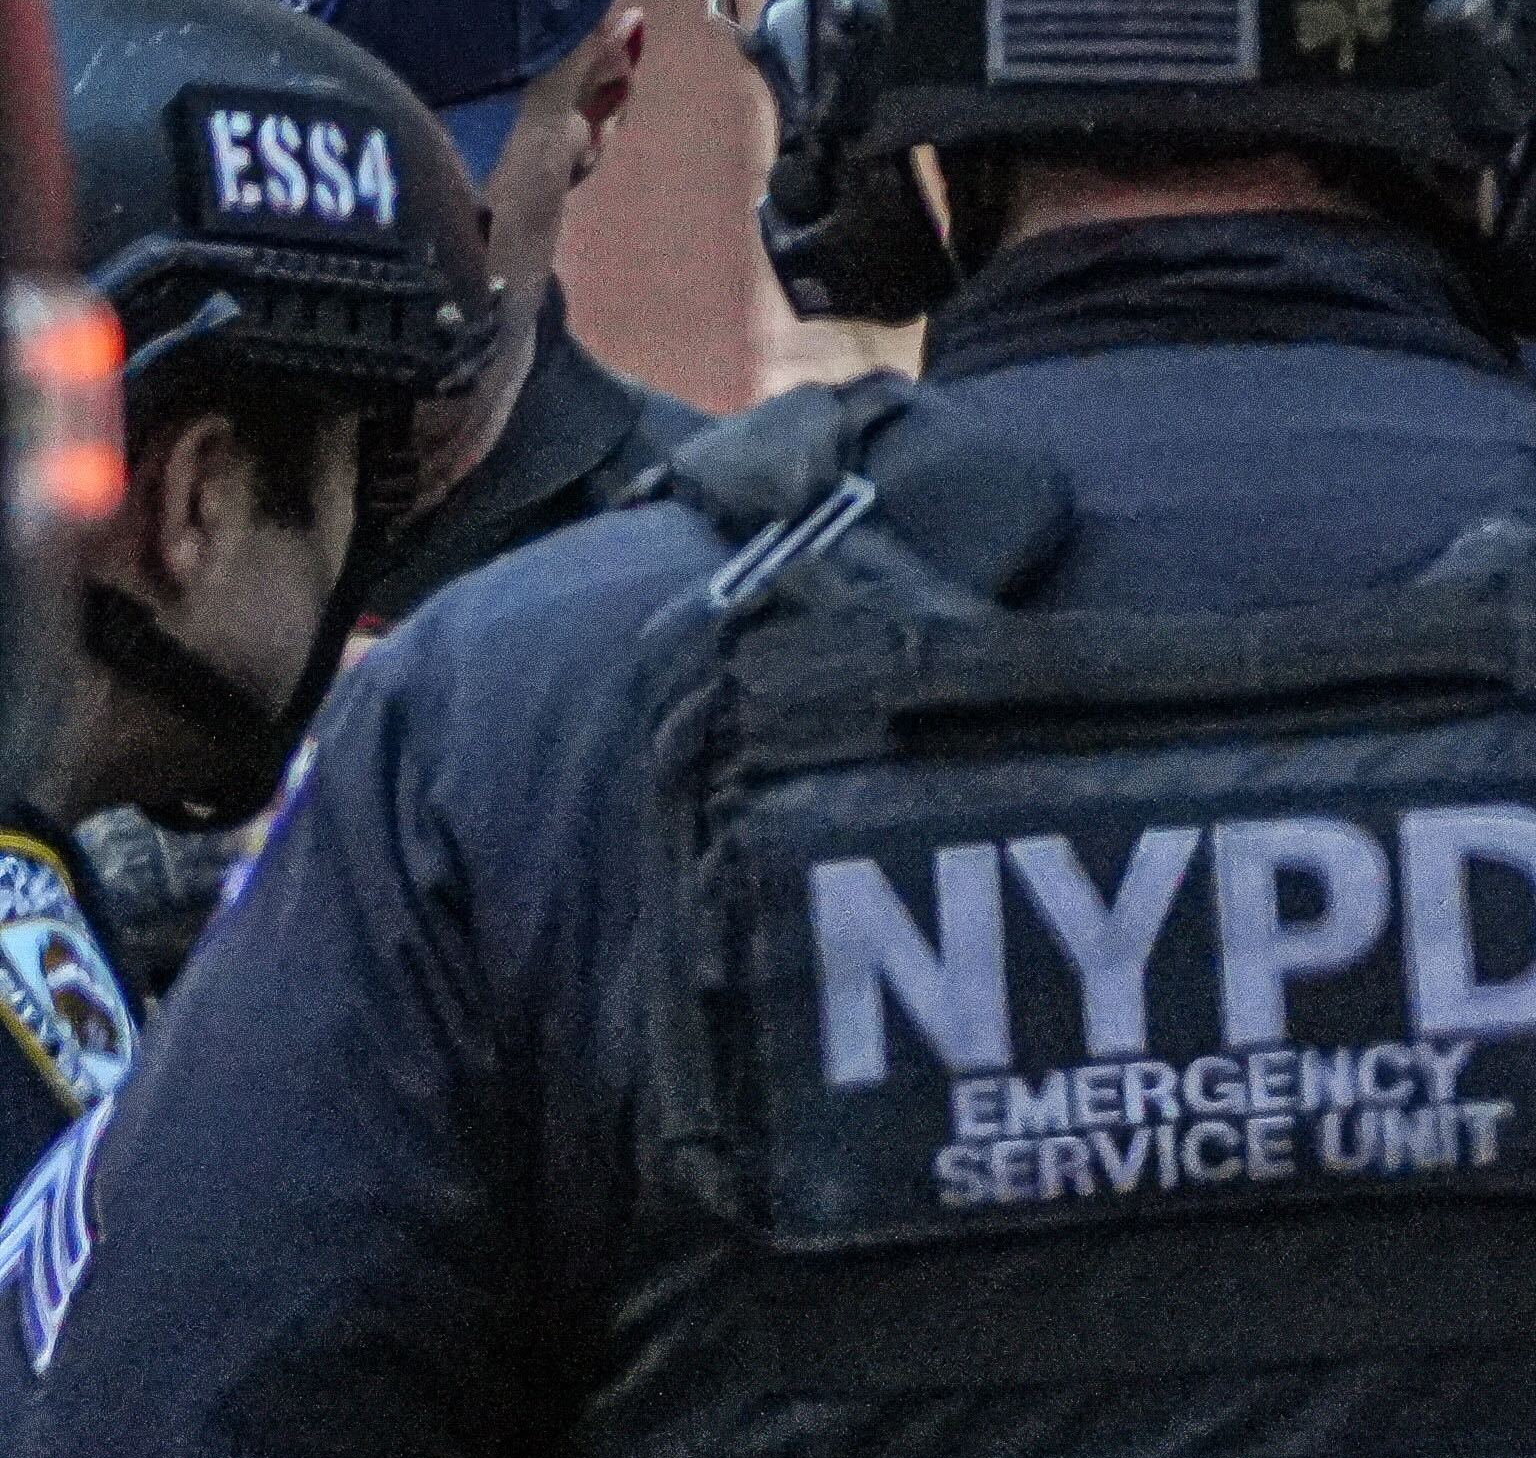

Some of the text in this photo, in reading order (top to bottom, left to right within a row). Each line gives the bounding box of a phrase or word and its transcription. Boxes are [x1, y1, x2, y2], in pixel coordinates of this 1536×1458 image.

[207, 109, 397, 226] ESS4
[948, 1039, 1476, 1140] EMERGENCY
[932, 1099, 1515, 1206] SERVICE UNIT
